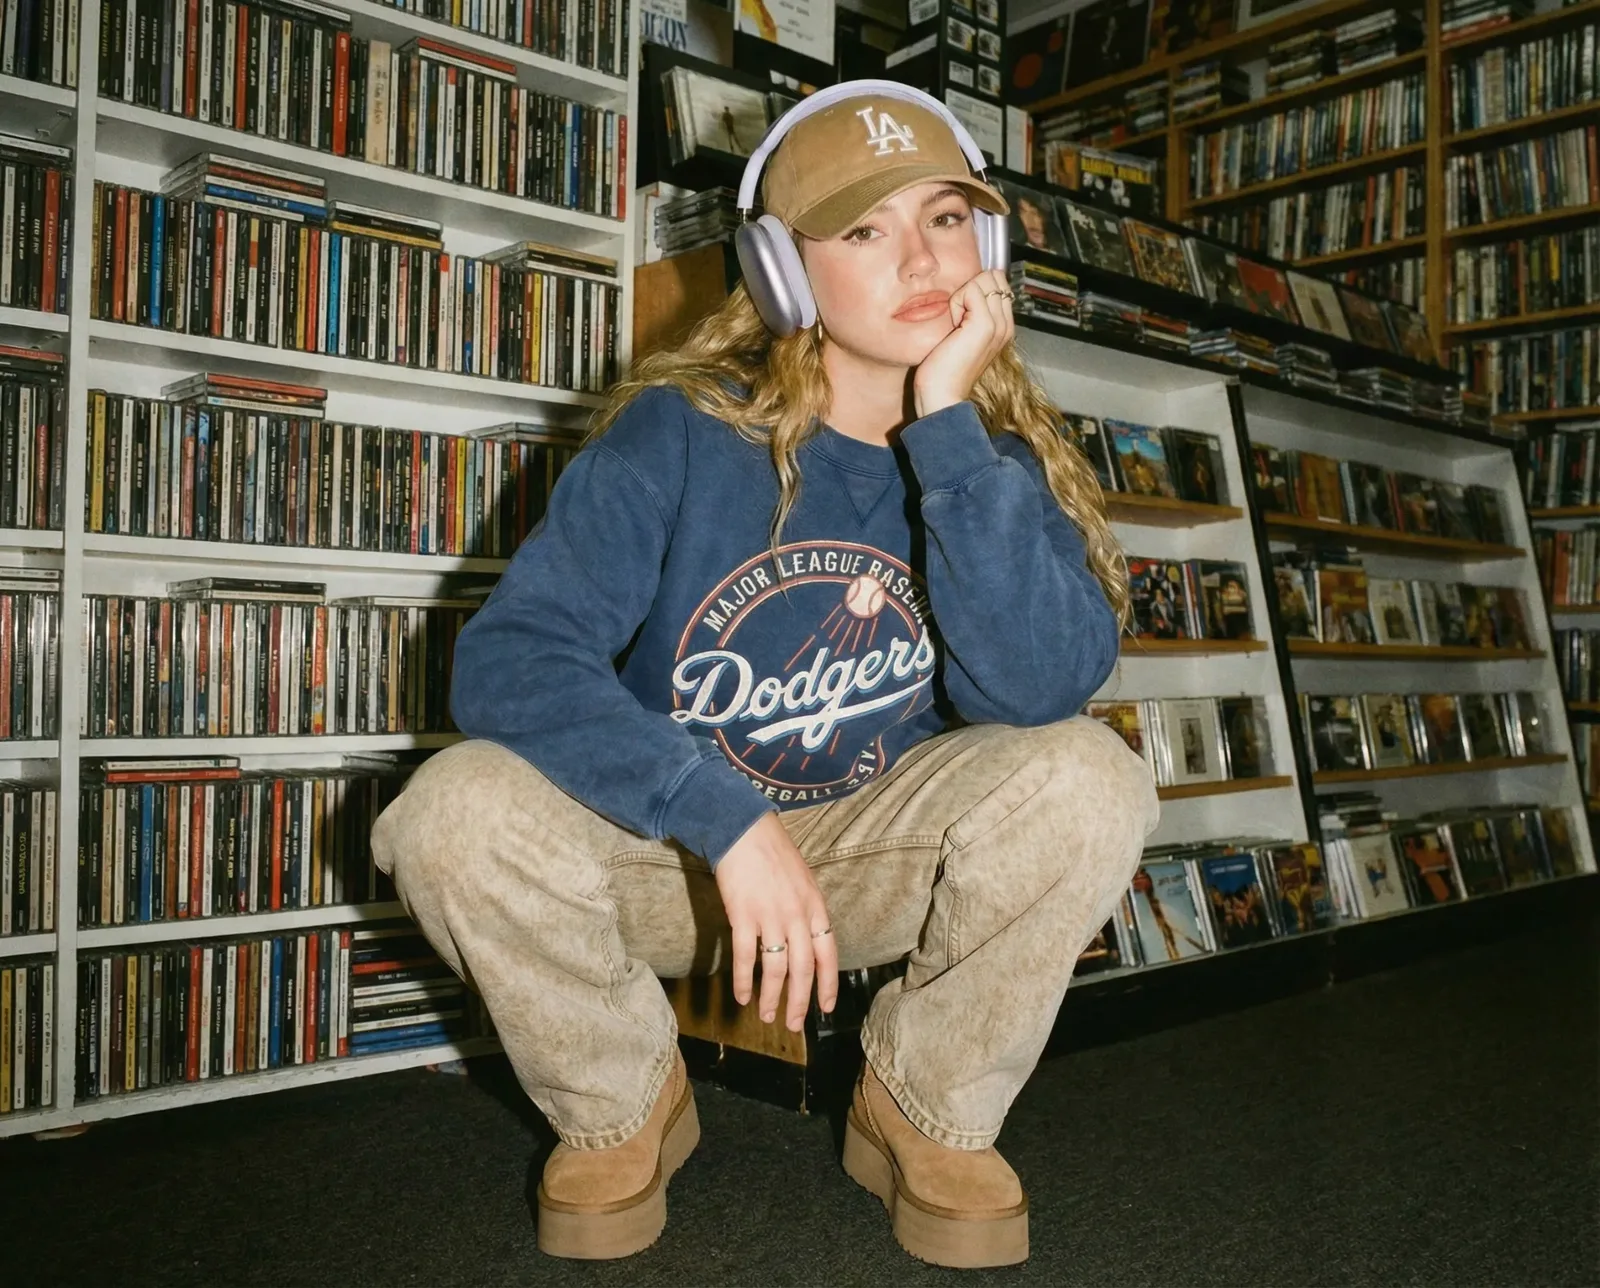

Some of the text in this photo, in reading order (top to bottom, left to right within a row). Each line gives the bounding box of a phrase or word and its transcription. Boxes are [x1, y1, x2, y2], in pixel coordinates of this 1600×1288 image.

[856, 105, 918, 156] LA
[703, 567, 771, 633] MAJOR
[777, 551, 864, 578] LEAGUE
[669, 627, 936, 751] Dodgers
